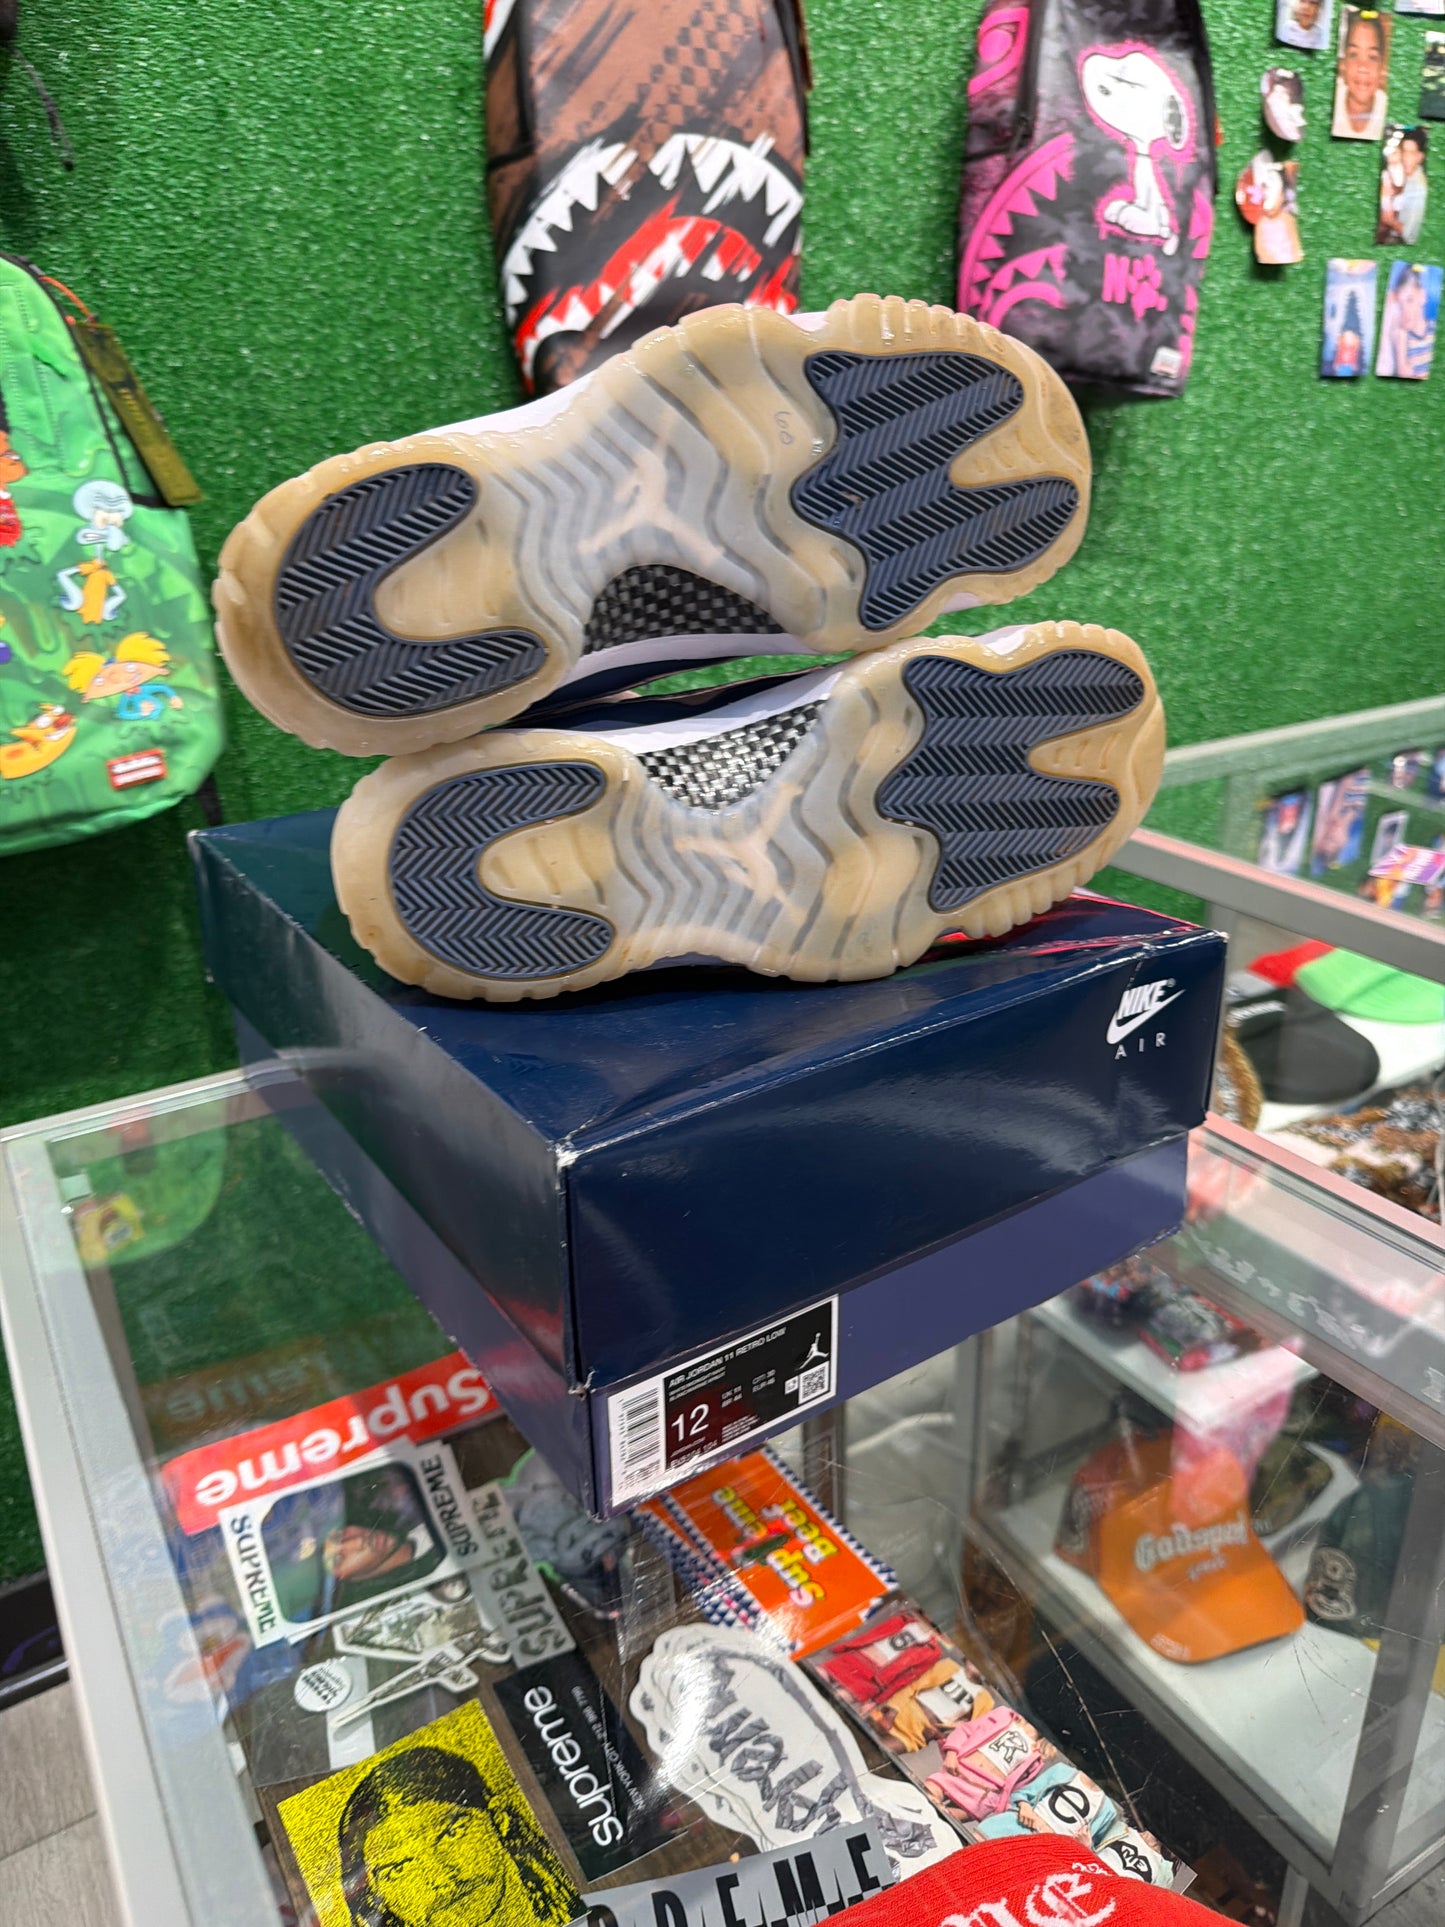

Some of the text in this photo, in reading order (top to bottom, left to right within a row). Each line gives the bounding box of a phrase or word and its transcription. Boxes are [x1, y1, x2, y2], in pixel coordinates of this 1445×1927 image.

[1117, 980, 1169, 1020] NIKE
[1114, 1031, 1167, 1061] AIR
[668, 1373, 685, 1388] AIR
[686, 1357, 723, 1379] JORDAN
[736, 1337, 764, 1356] RETRO
[766, 1327, 785, 1341] LOW
[195, 1368, 490, 1507] Supreme
[671, 1404, 709, 1442] 12
[420, 1453, 478, 1557] SUPREME
[231, 1514, 276, 1634] SUPREME
[712, 1486, 826, 1608] Supeme
[524, 1685, 624, 1847] supreme
[614, 1760, 634, 1787] YORK
[628, 1786, 646, 1810] NEW
